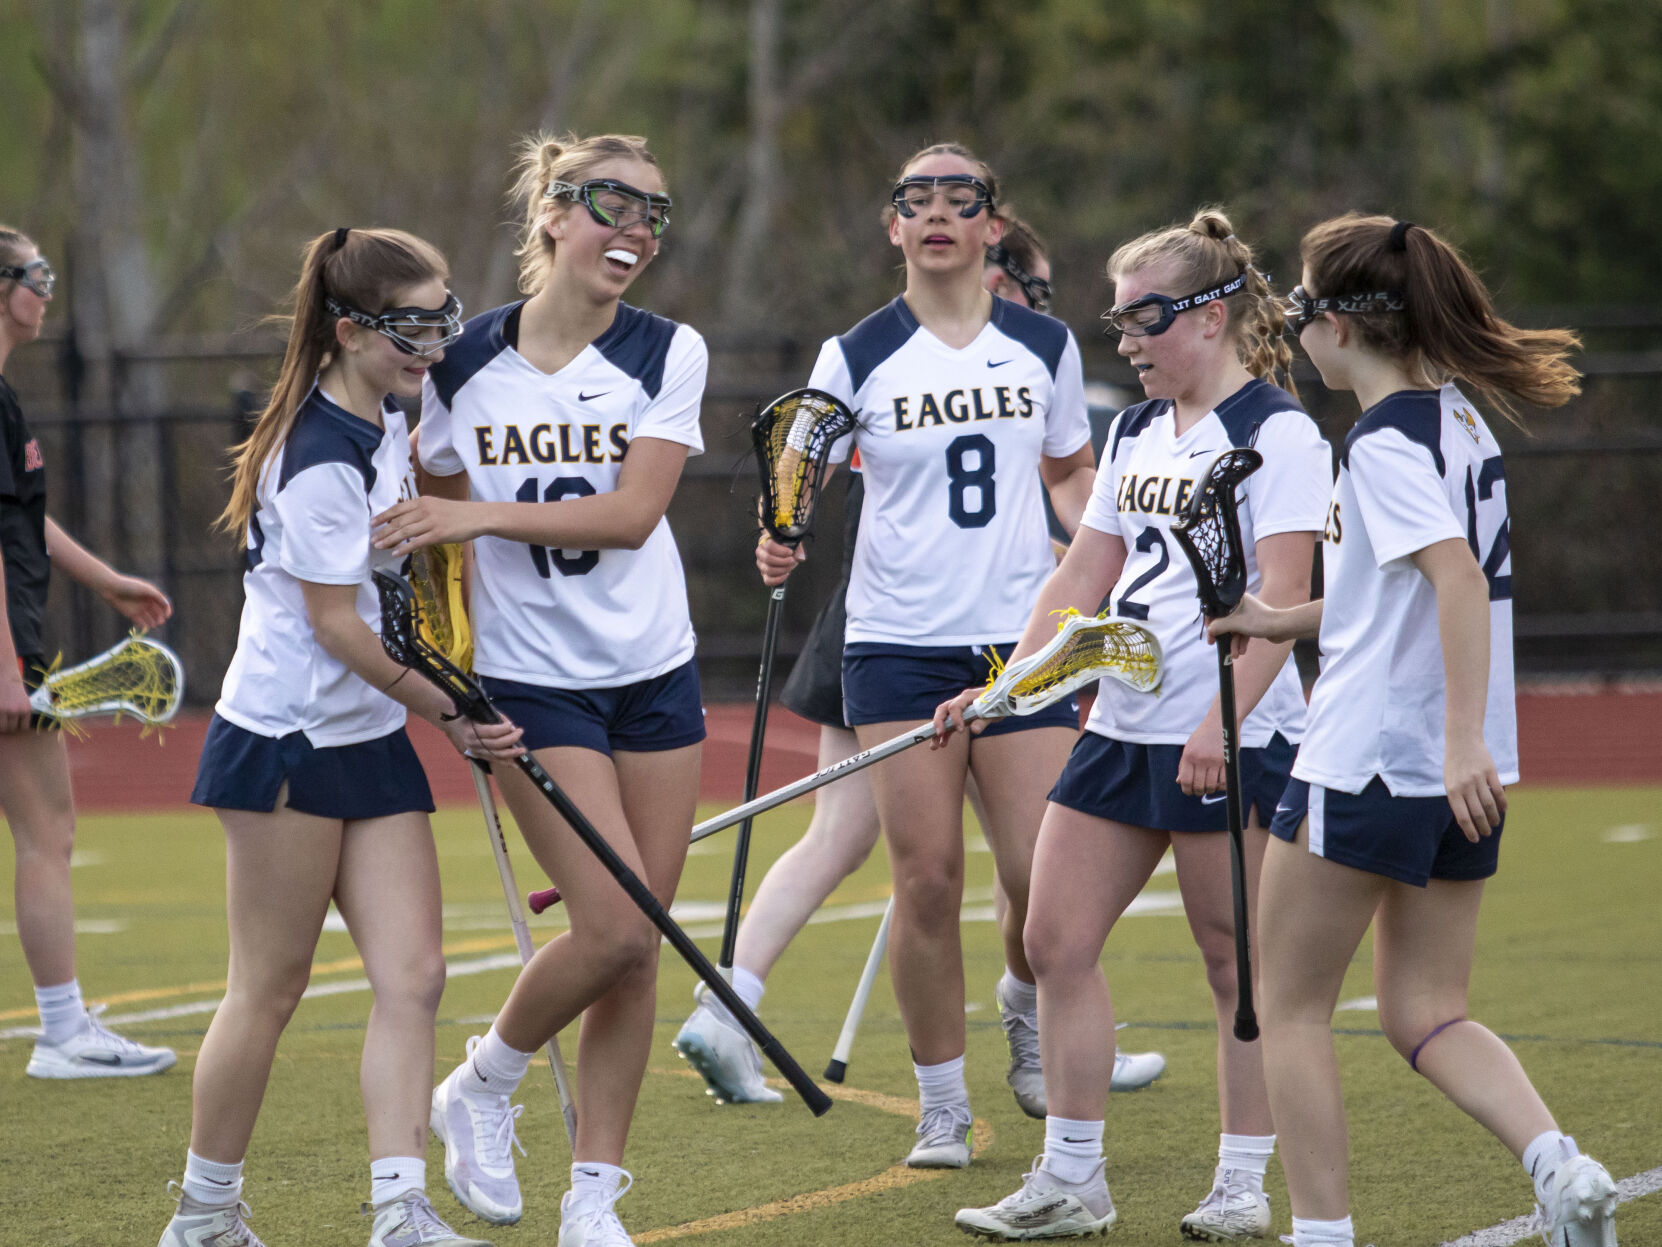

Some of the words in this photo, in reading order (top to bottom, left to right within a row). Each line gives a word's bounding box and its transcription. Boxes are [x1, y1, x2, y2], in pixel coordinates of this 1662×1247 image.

[1194, 289, 1220, 304] GAIT
[350, 311, 379, 329] STX
[893, 386, 1033, 432] EAGLES
[474, 423, 631, 466] EAGLES
[945, 433, 996, 529] 8
[1117, 526, 1169, 621] 2
